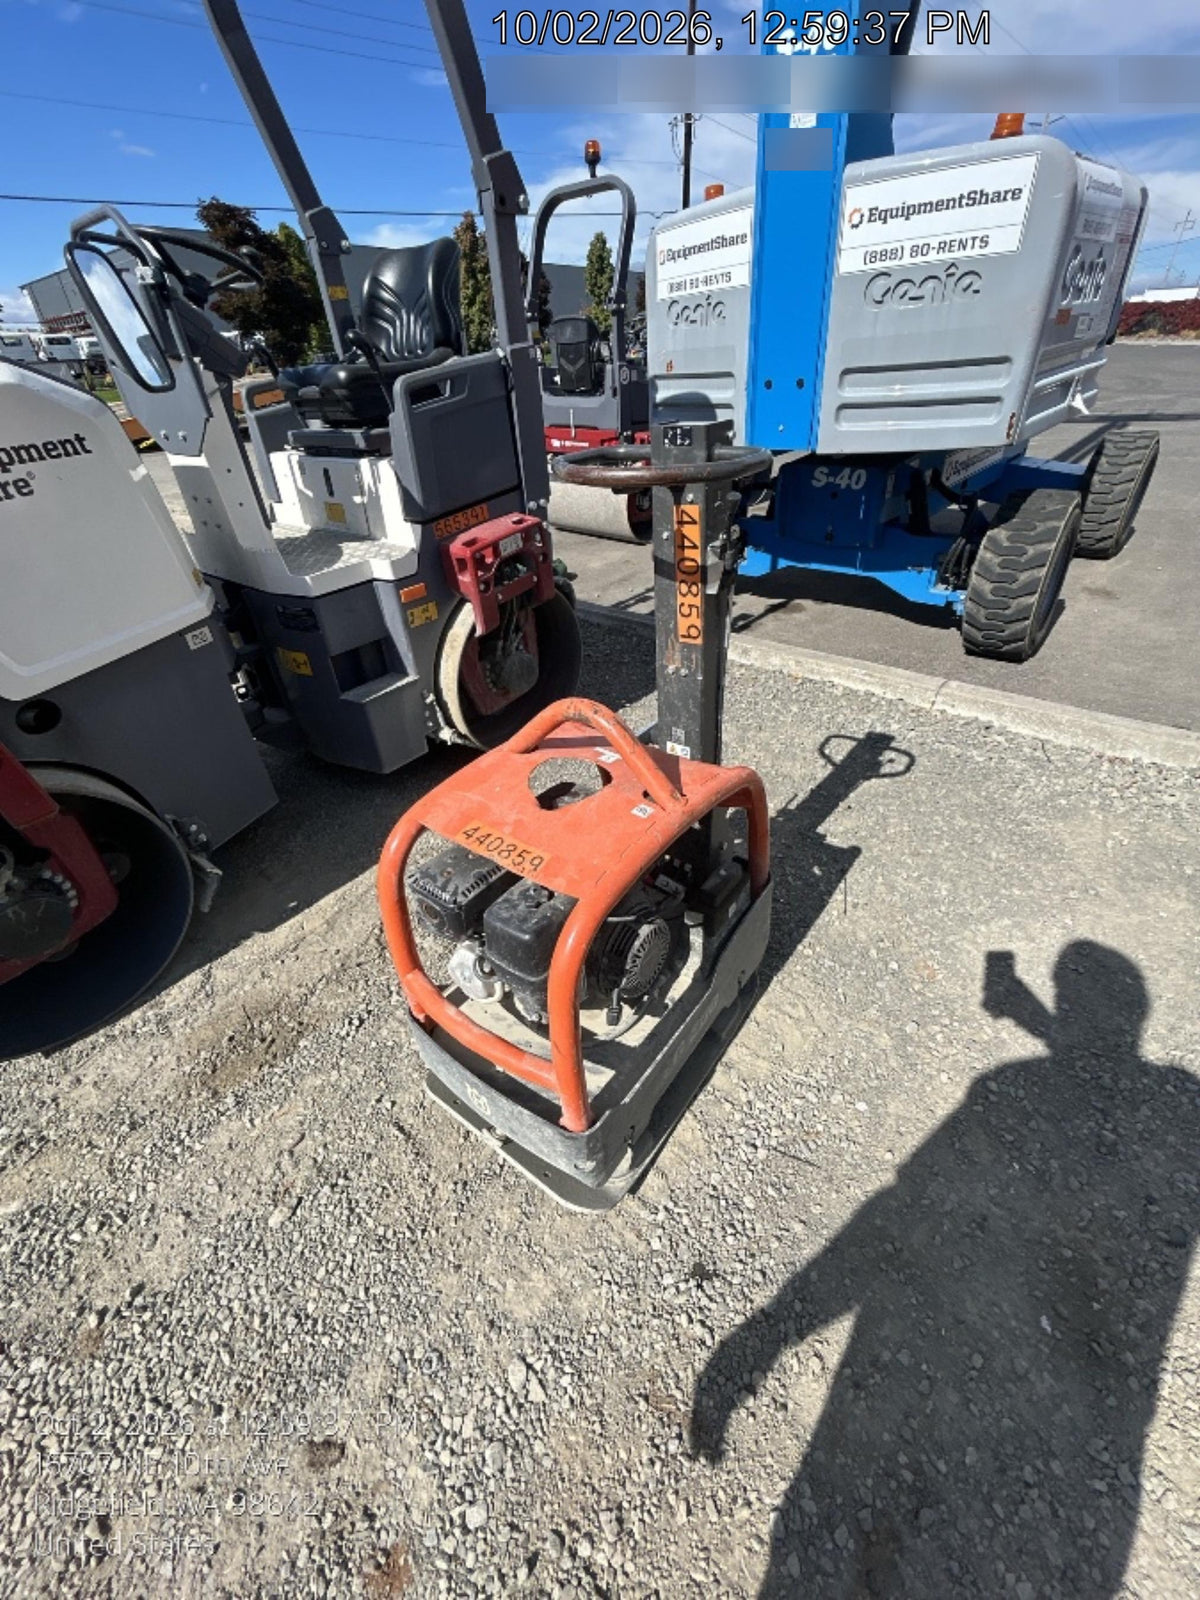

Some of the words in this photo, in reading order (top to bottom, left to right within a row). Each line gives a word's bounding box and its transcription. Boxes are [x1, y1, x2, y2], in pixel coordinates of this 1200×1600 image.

[867, 186, 1022, 224] EquipmentShare
[666, 232, 748, 264] EquipmentShare
[863, 245, 904, 266] (888)
[909, 234, 990, 259] 80-RENTS
[864, 262, 983, 311] Genie
[811, 465, 867, 490] S-40
[675, 509, 701, 640] 440859
[462, 825, 545, 872] 440859
